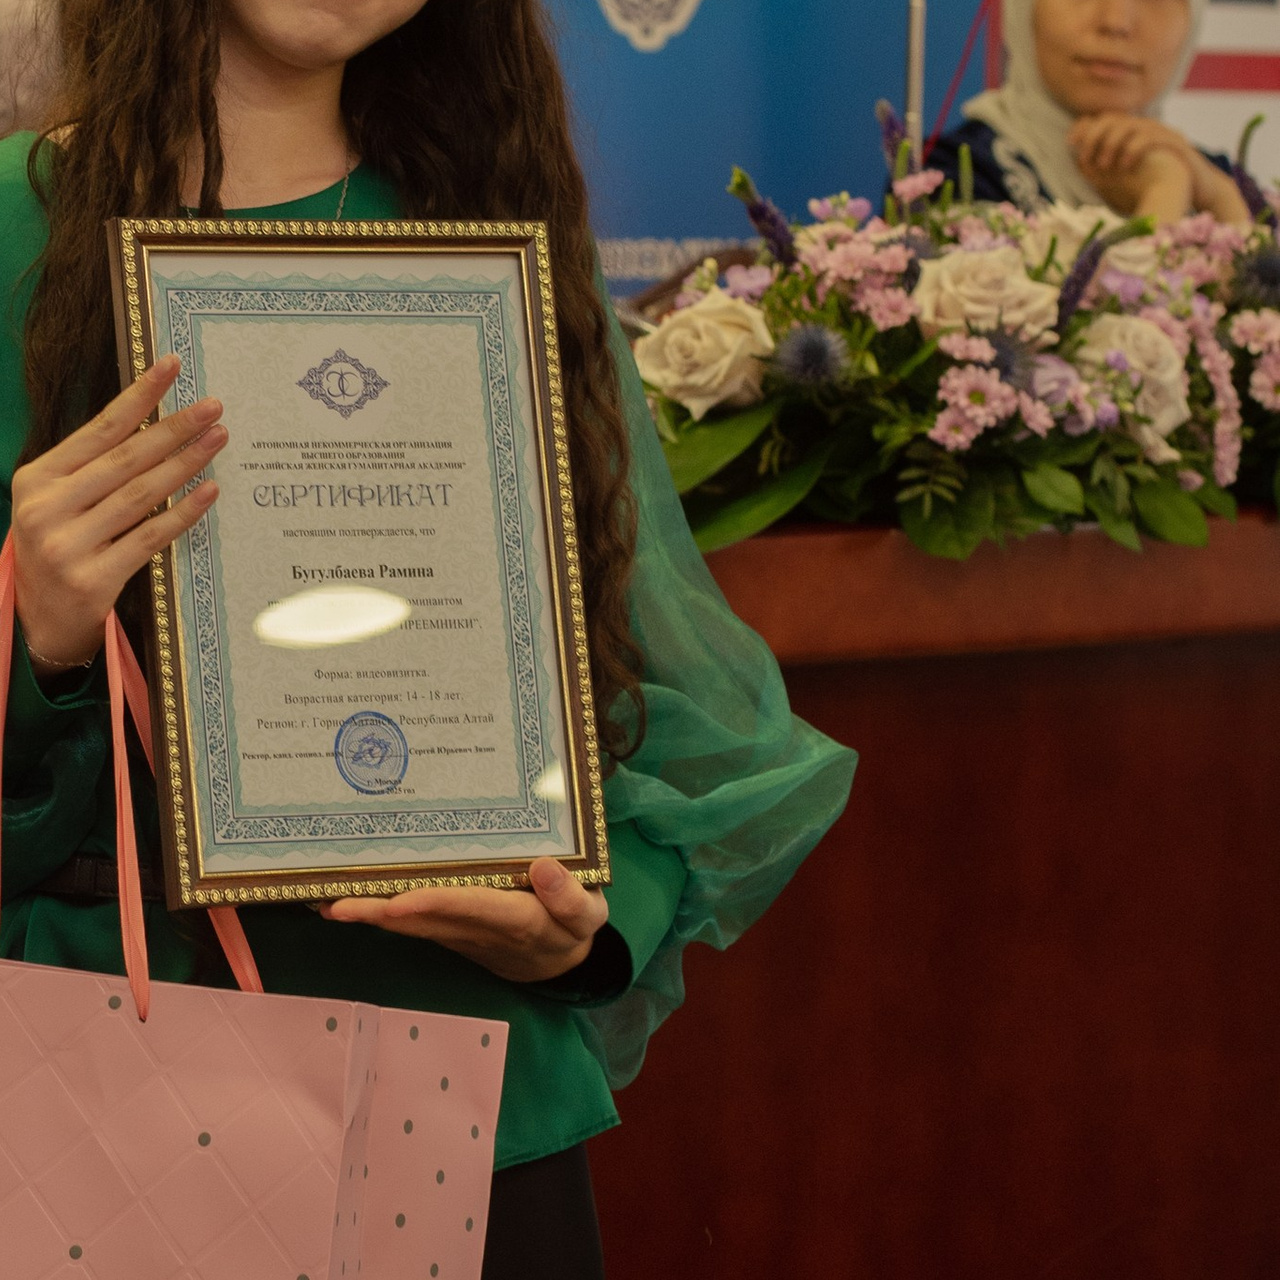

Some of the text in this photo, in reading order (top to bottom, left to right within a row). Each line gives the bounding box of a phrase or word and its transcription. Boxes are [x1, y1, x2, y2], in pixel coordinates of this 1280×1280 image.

[251, 441, 453, 450] АВТОНОМНАЯ НЕКОММЕРЧЕСКАЯ ОРГАНИЗАЦИЯ
[301, 451, 406, 460] ВЫСШЕГО ОБРАЗОВАНИЯ
[304, 462, 347, 470] ЖЕНСКАЯ
[347, 462, 416, 470] ГУМАНИТАРНАЯ
[252, 483, 454, 508] СЕРТИФИКАТ
[282, 527, 436, 539] настоящим подтверждается, что
[292, 564, 434, 583] Бугулбаева Рамина
[314, 669, 430, 680] Форма: видеовизитка.
[284, 693, 344, 706] Возрастная
[347, 693, 403, 704] категория:
[406, 691, 418, 702] 14
[429, 691, 441, 701] 18
[443, 691, 464, 701] лет.
[257, 718, 298, 730] Регион:
[301, 720, 310, 728] г.
[399, 714, 460, 726] Республика
[462, 713, 495, 724] Алтай
[408, 746, 435, 757] Сергей
[436, 745, 472, 756] Юрьевич
